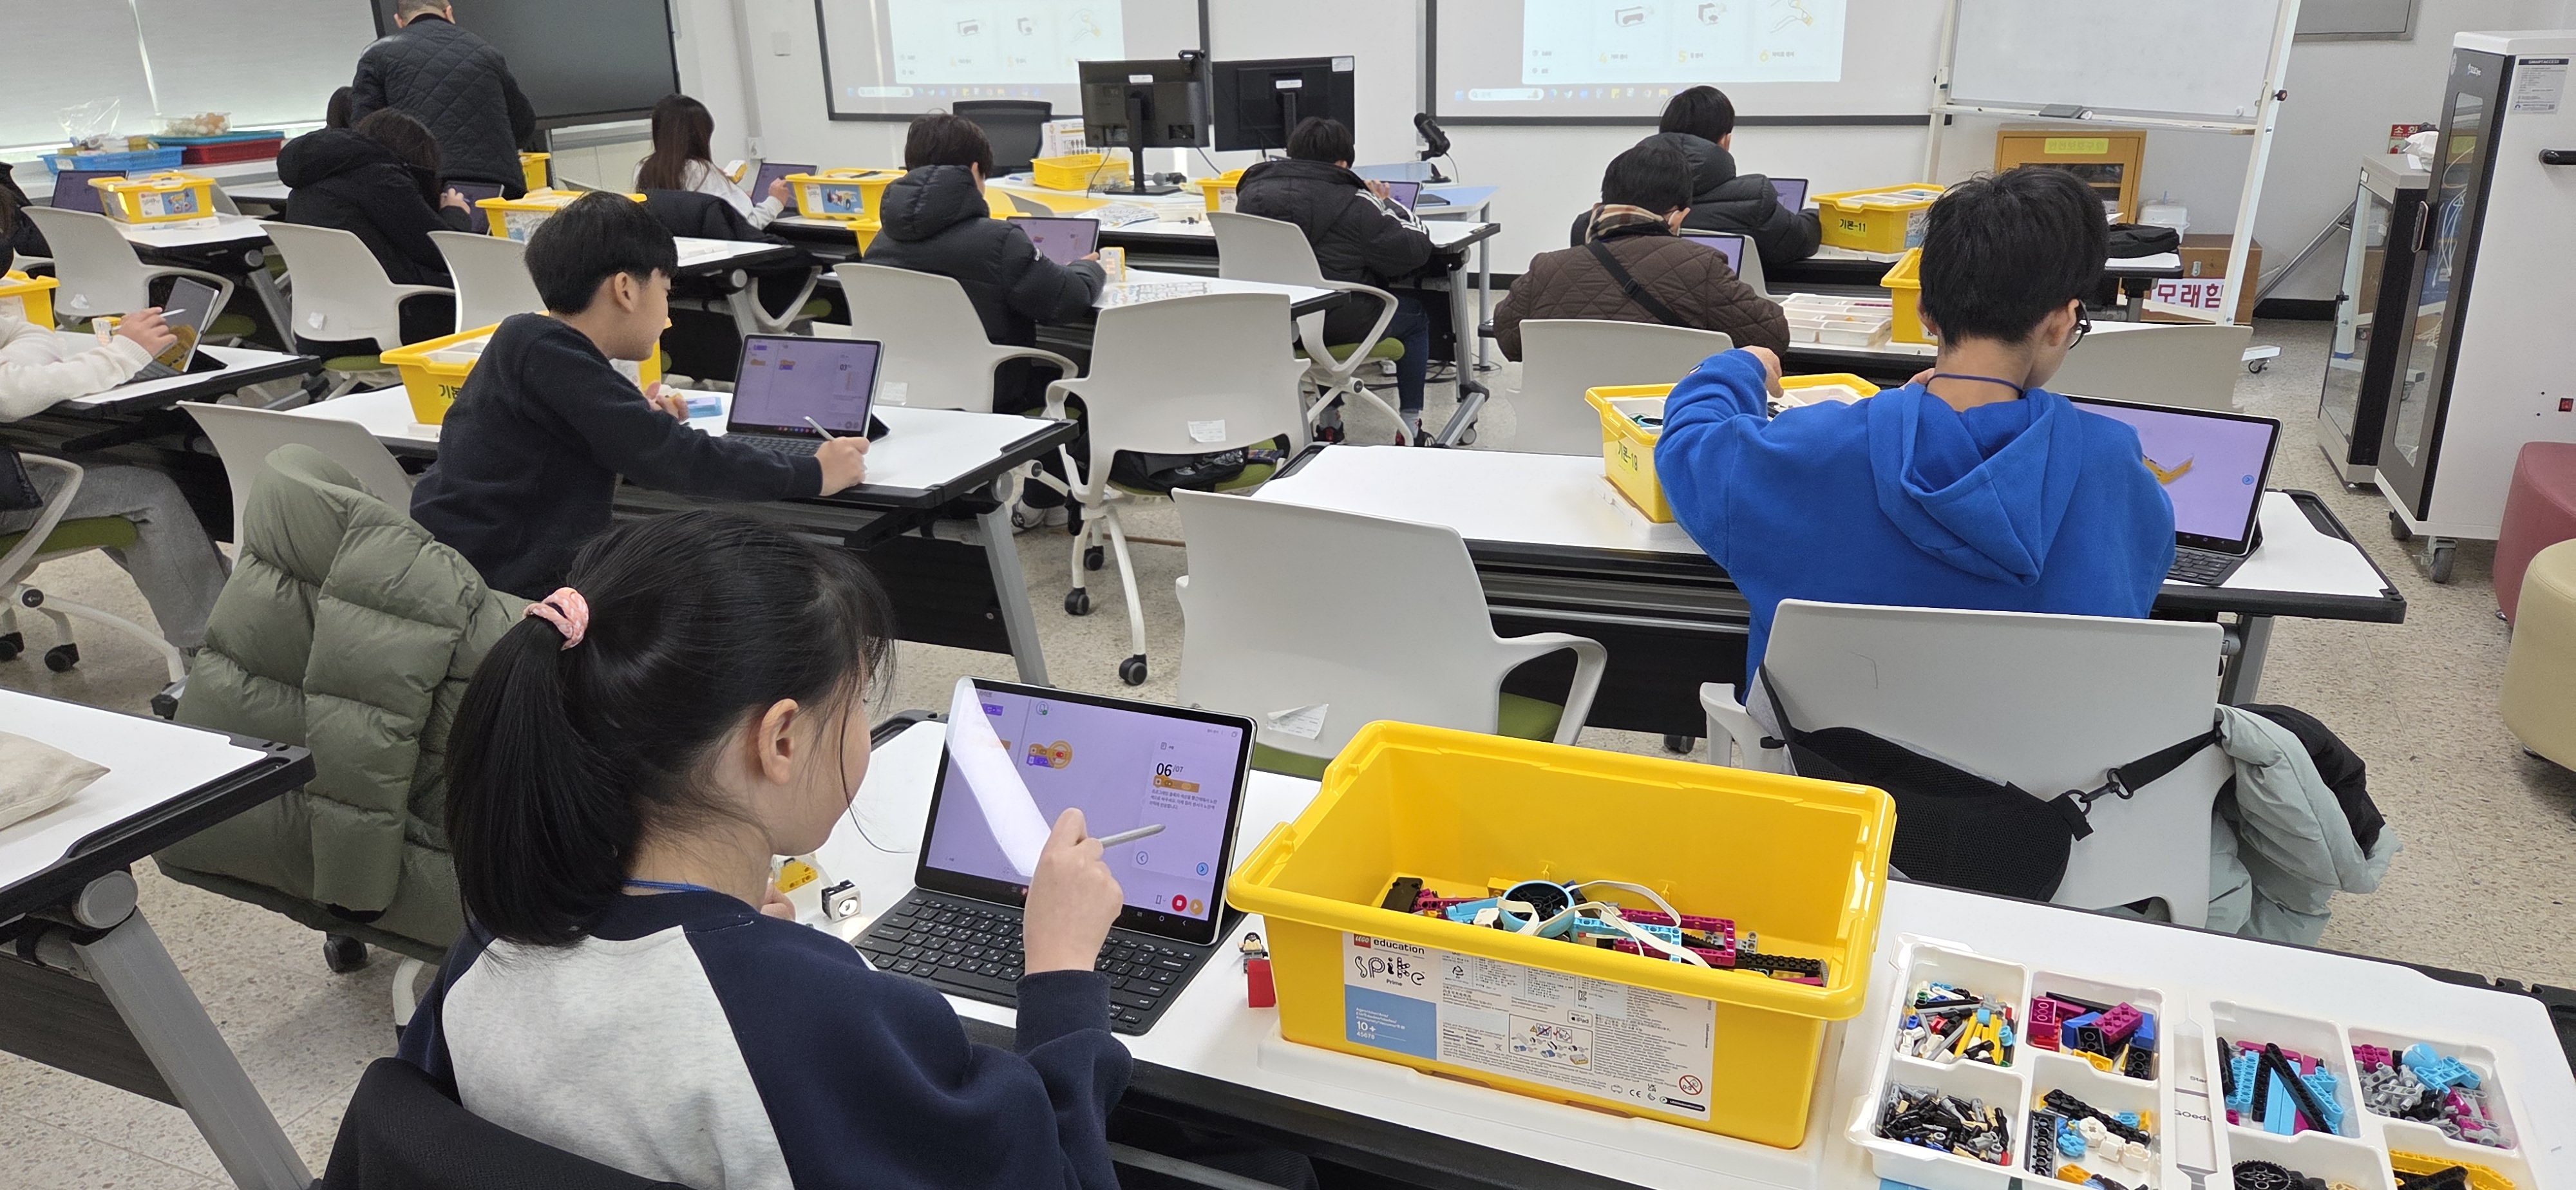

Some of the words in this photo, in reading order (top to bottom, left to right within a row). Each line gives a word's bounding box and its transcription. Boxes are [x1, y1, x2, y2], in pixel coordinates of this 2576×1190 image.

[1678, 50, 1686, 63] 5
[1759, 50, 1769, 62] 6
[1840, 219, 1866, 232] 기본-11
[1618, 440, 1638, 471] 기본-19
[1157, 762, 1172, 777] 06
[1373, 939, 1425, 955] education
[1387, 978, 1403, 987] Prime
[1357, 1021, 1376, 1032] 10+
[1357, 1031, 1375, 1040] 45678
